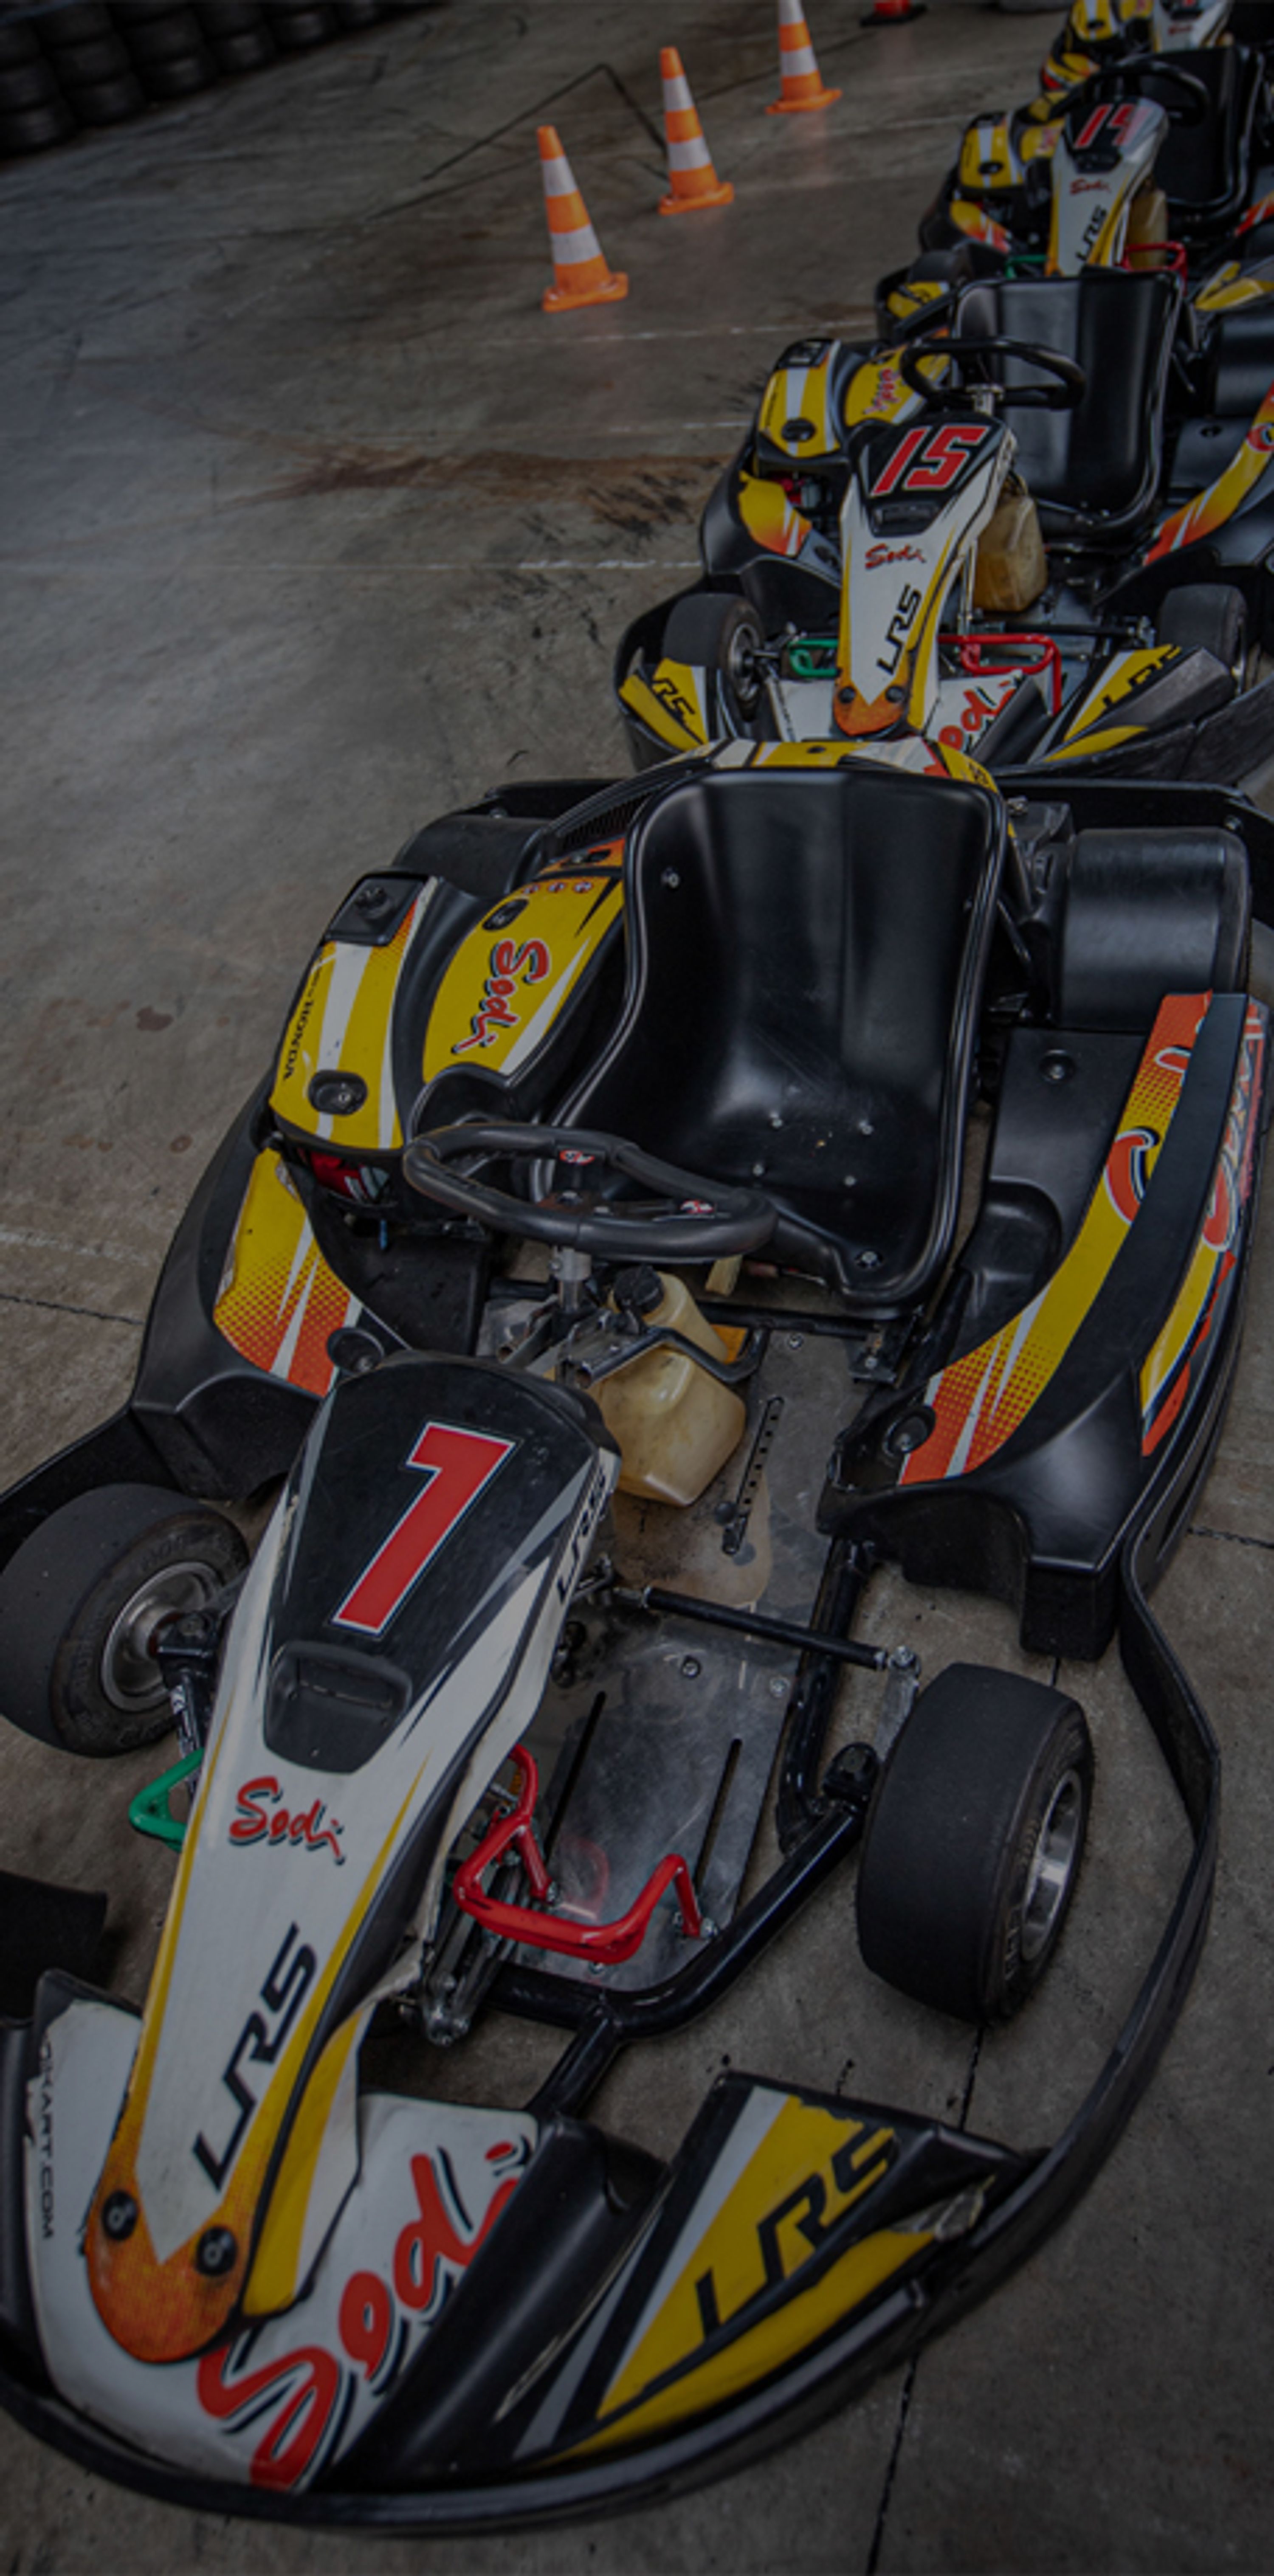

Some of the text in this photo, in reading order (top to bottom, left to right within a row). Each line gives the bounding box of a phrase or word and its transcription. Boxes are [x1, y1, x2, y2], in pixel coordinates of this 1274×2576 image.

[868, 424, 990, 499] 15
[876, 584, 921, 674] LRS
[452, 938, 549, 1054] Sodi
[329, 1420, 519, 1637] 1
[229, 1776, 345, 1865] Sodi
[193, 1920, 316, 2192] LRS
